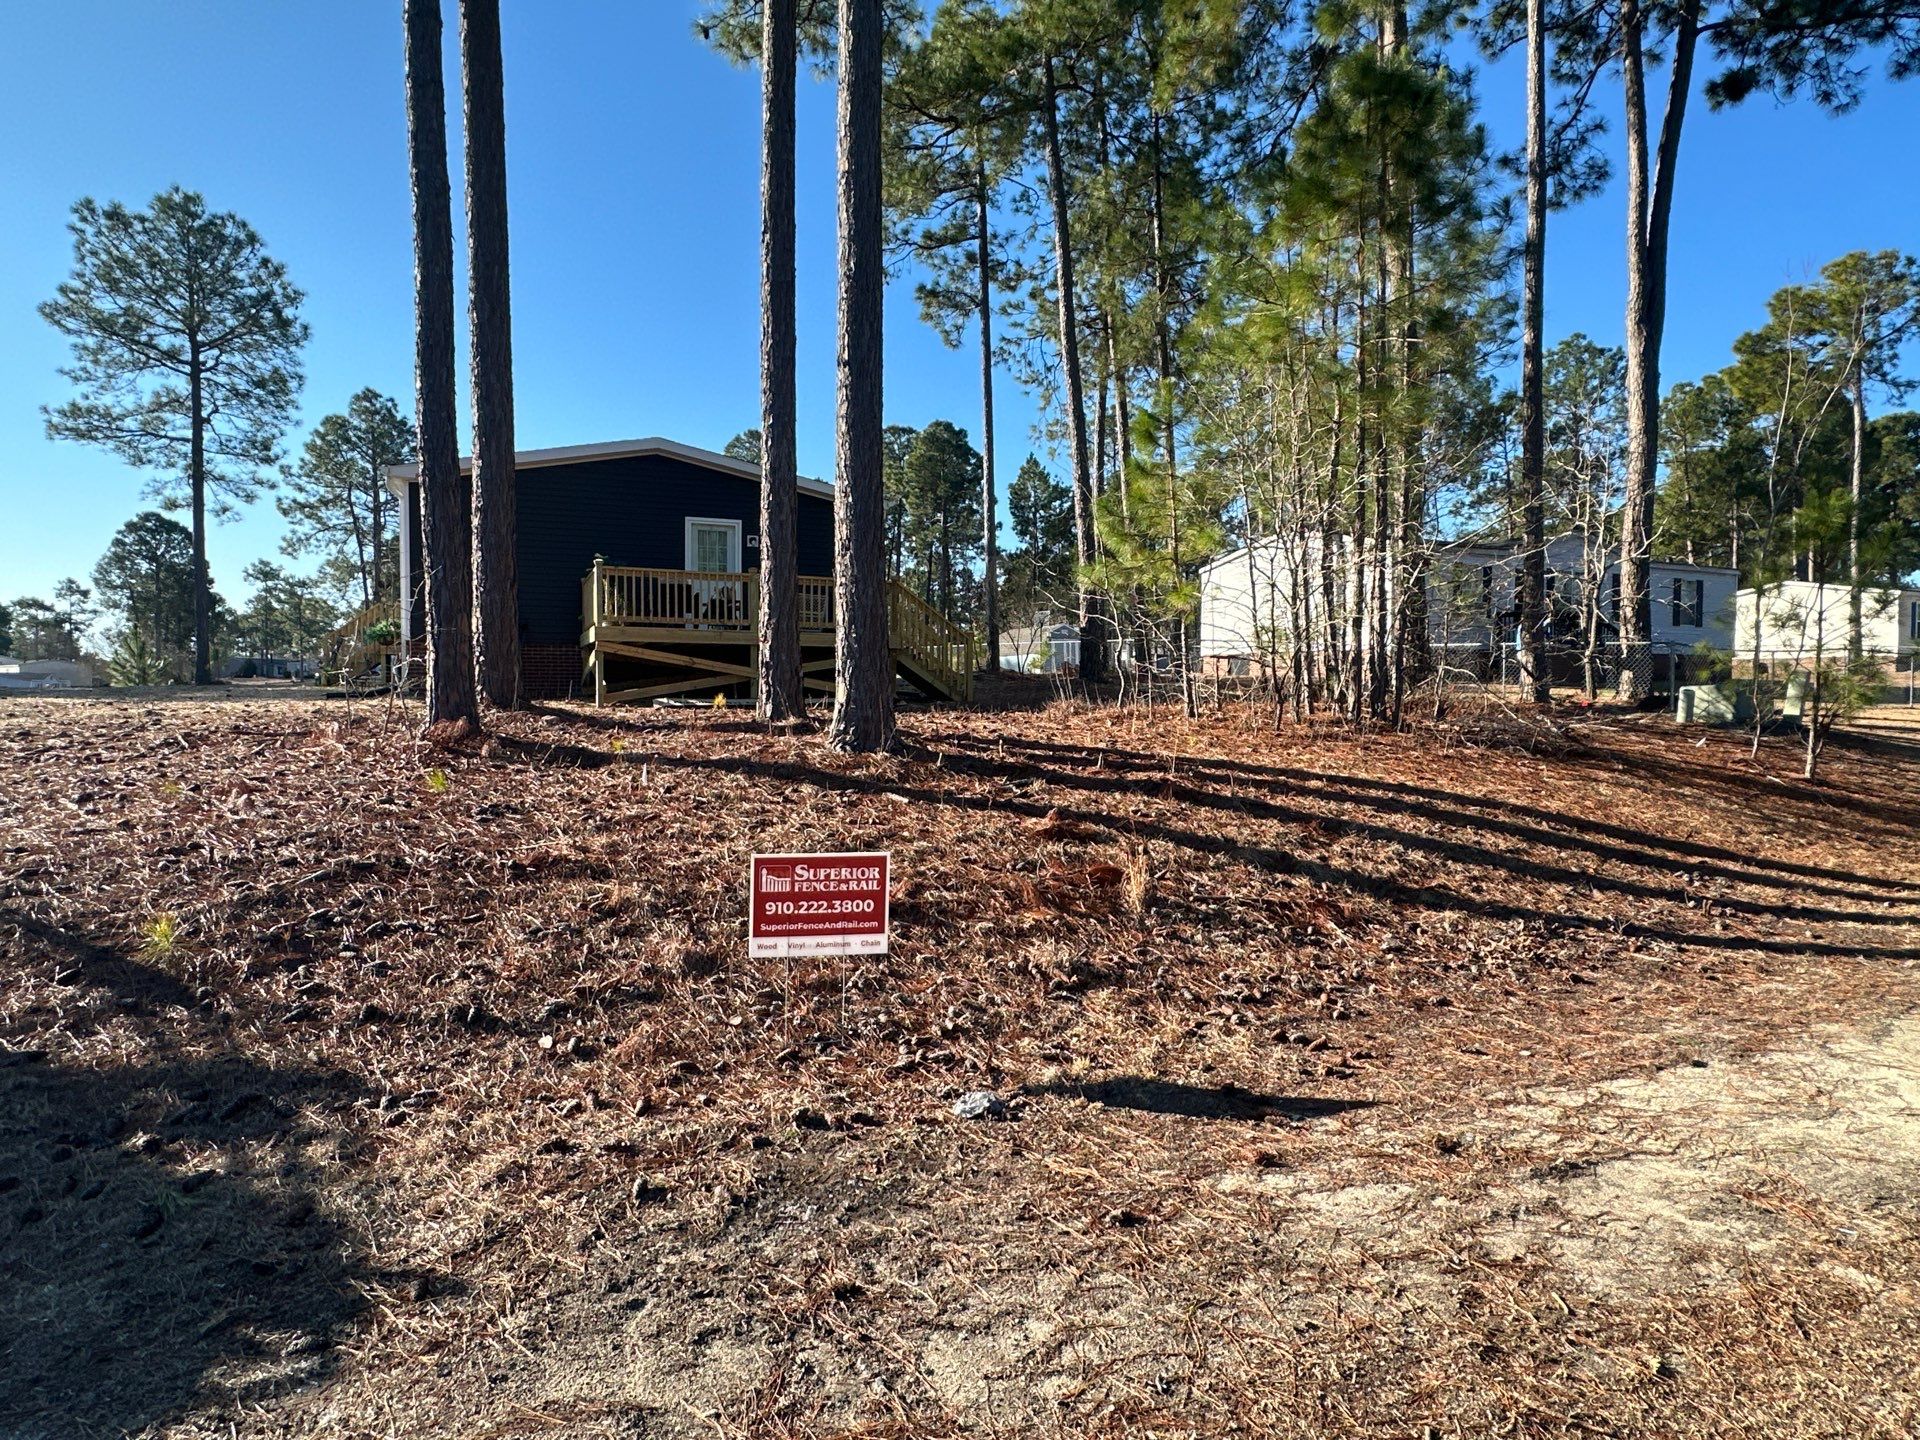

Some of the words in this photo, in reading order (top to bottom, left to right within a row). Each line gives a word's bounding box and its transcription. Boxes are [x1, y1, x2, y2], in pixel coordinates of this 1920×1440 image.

[765, 899, 875, 915] 910.222.3800
[760, 920, 878, 932] SuperiorFenceAndRail.com
[788, 942, 806, 950] Vinyl
[815, 941, 851, 949] Aluminum
[860, 939, 881, 947] Chain
